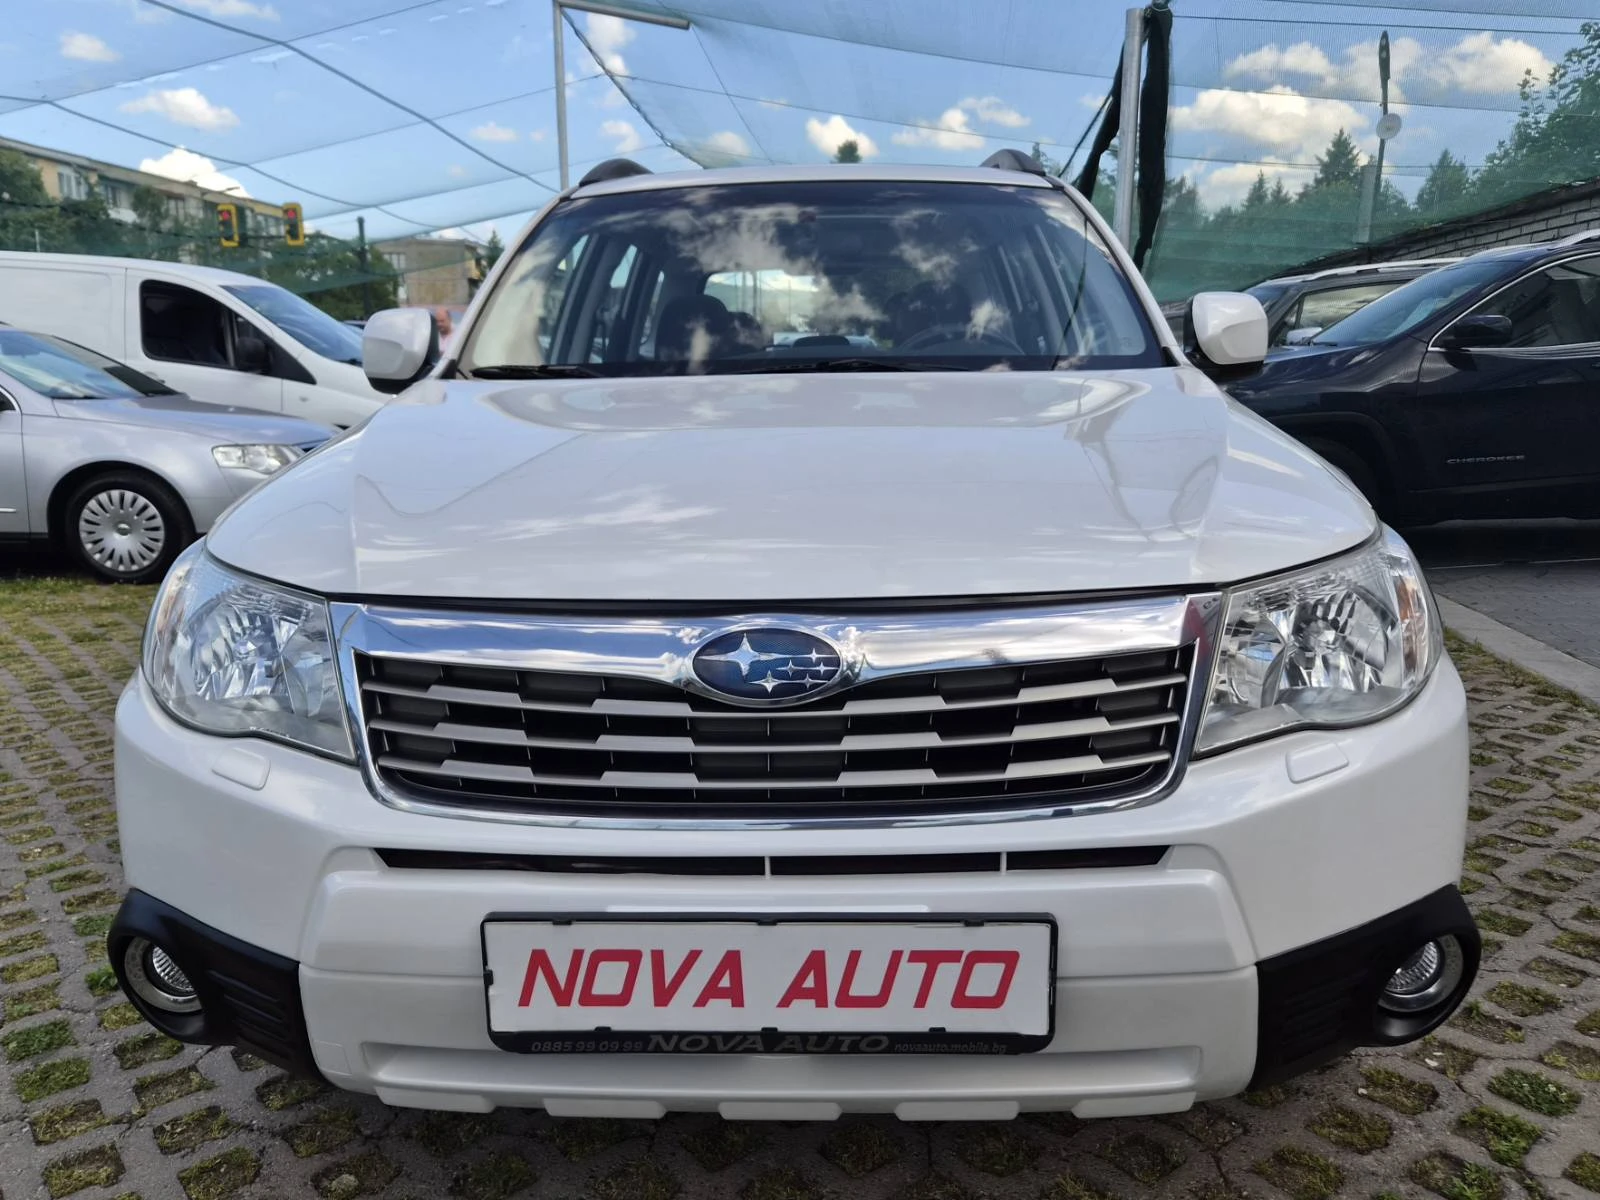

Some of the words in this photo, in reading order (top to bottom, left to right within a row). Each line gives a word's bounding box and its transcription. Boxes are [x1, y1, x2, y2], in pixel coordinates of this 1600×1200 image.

[1447, 455, 1525, 464] CHEROKEE
[518, 949, 745, 1008] NOVA
[776, 949, 1020, 1009] AUTO
[531, 1041, 572, 1052] 0885
[575, 1041, 595, 1052] 99
[598, 1041, 619, 1052] 09
[622, 1041, 643, 1052] 99
[648, 1034, 765, 1052] NOVA
[772, 1035, 890, 1052] AUTO
